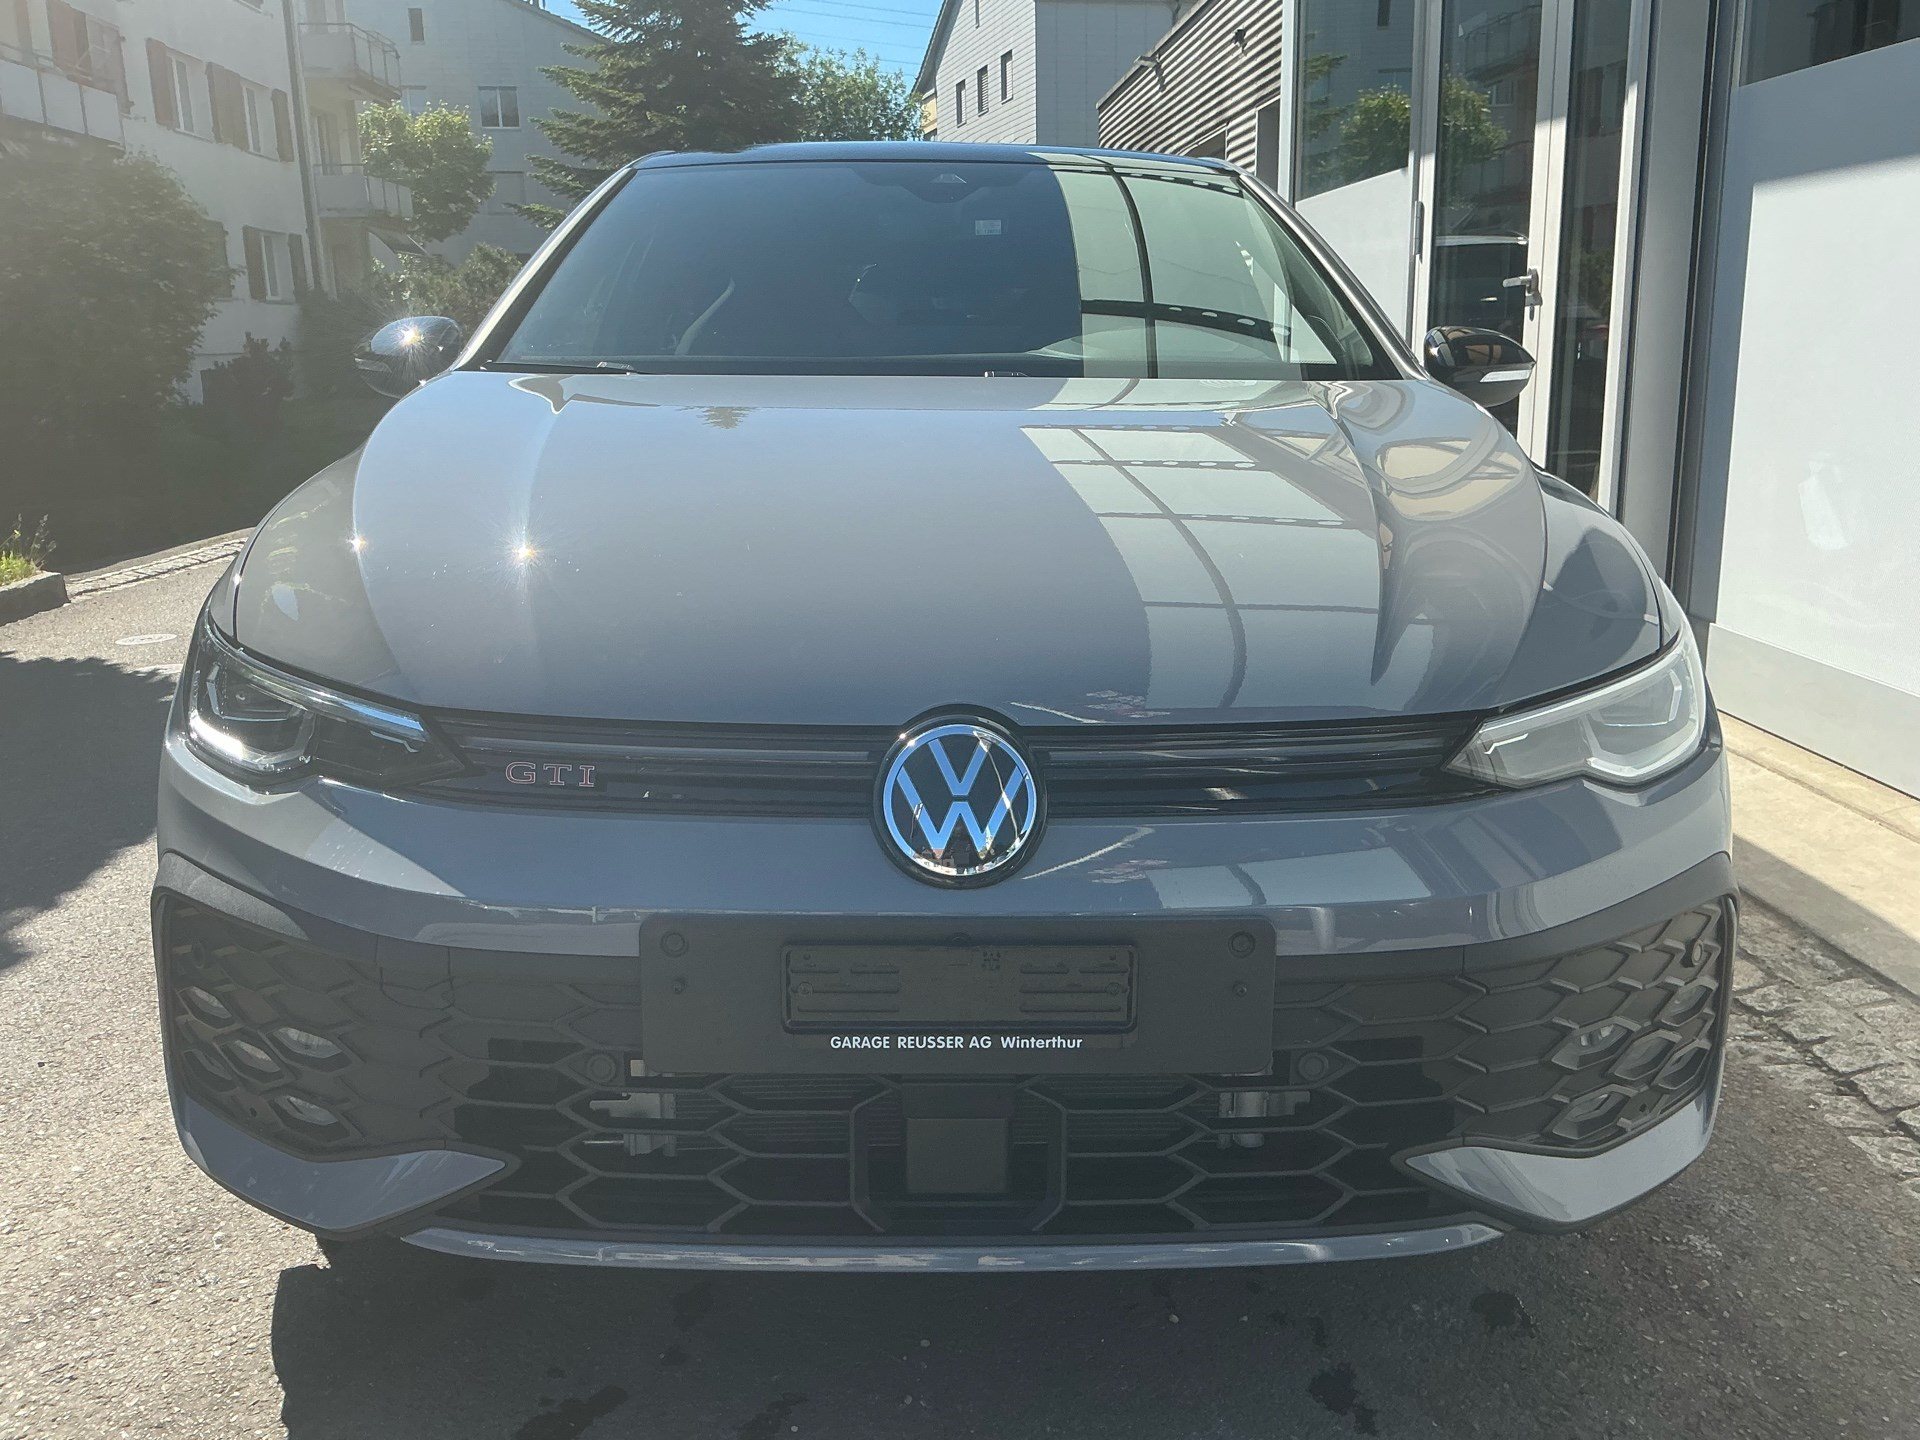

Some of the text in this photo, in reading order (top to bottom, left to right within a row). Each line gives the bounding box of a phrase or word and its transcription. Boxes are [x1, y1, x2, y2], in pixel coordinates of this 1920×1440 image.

[505, 761, 595, 787] GTI
[888, 730, 1032, 868] VW
[830, 1036, 1083, 1049] GARAGE REUSSER AG Winterthur
